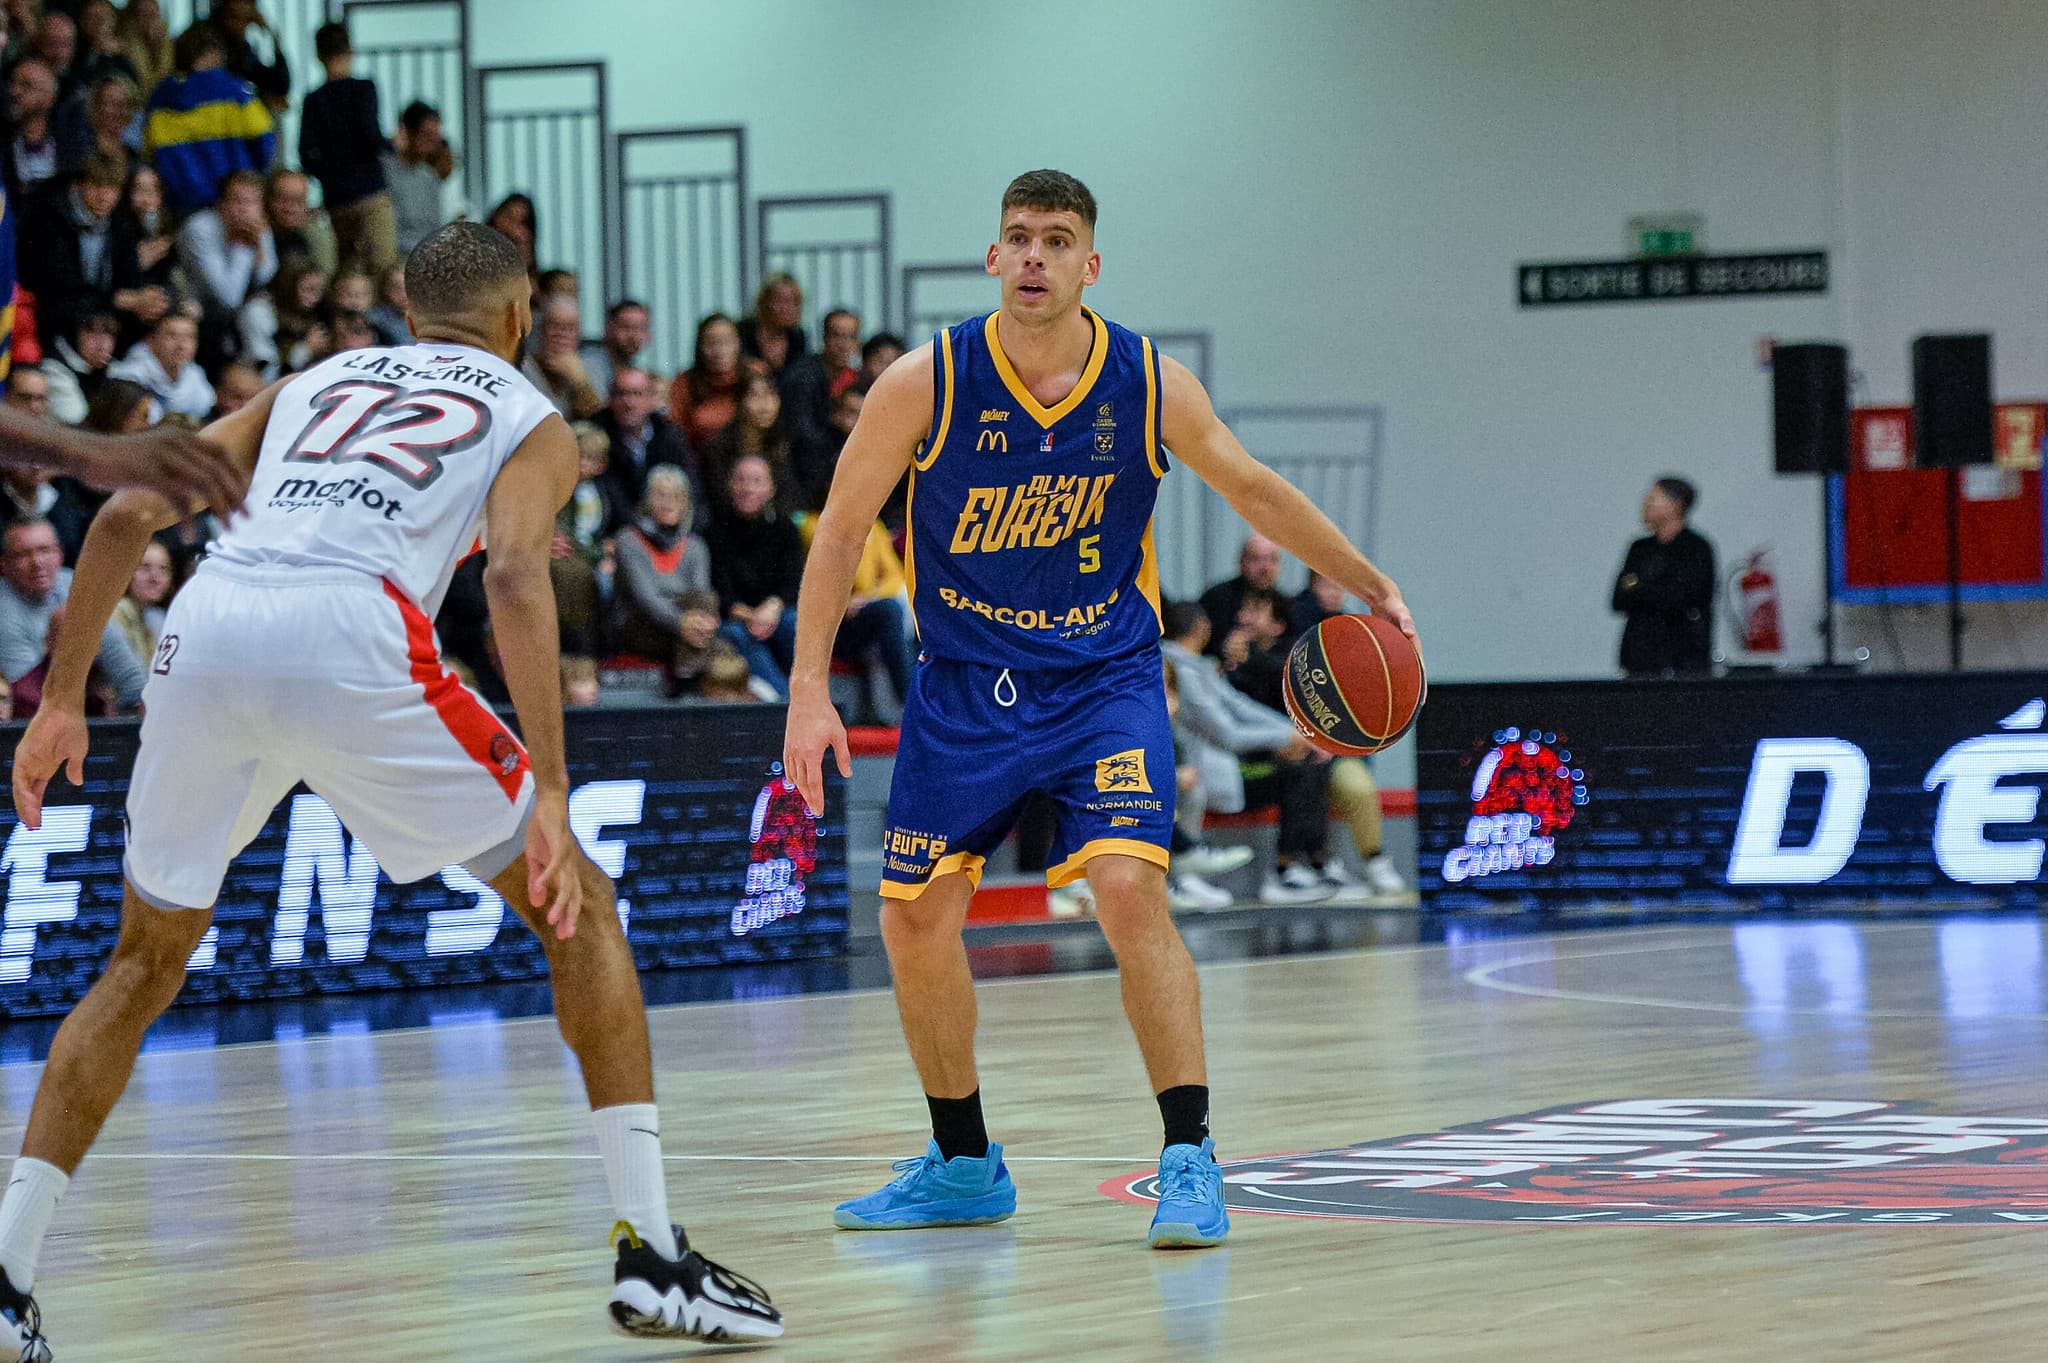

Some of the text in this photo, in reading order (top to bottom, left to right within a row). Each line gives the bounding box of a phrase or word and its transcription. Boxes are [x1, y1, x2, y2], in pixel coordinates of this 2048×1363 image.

[283, 379, 493, 491] 12
[1027, 475, 1077, 497] ALM
[1079, 534, 1101, 574] 5
[1086, 799, 1163, 812] NORMANDIE
